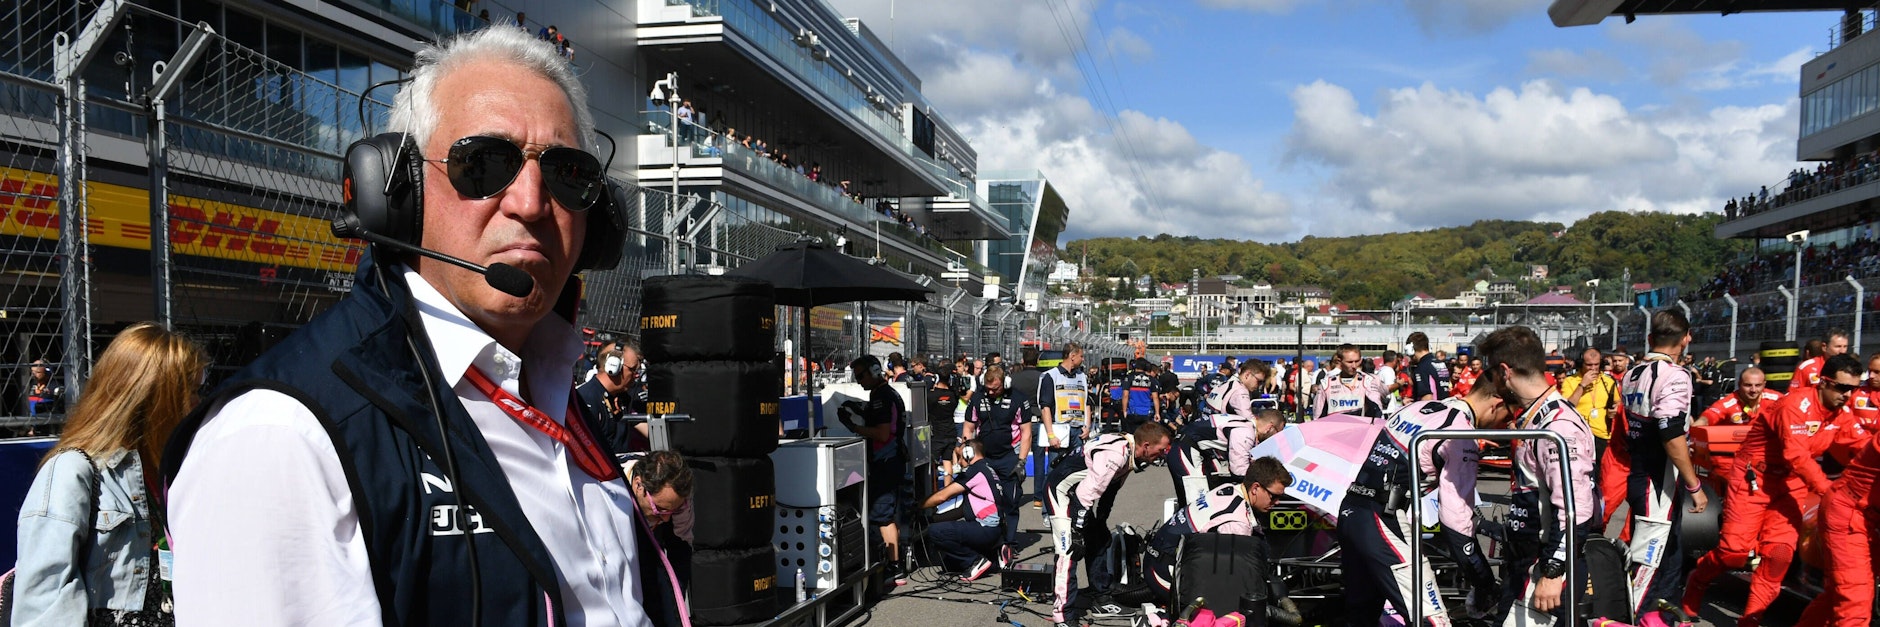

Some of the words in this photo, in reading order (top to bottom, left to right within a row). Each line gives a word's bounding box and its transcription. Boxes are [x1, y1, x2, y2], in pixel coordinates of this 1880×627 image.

[168, 203, 288, 256] DHL
[649, 315, 677, 328] FRONT
[1339, 399, 1359, 407] BWT
[1296, 480, 1334, 502] BWT
[750, 495, 769, 509] LEFT
[1428, 590, 1441, 611] BWT
